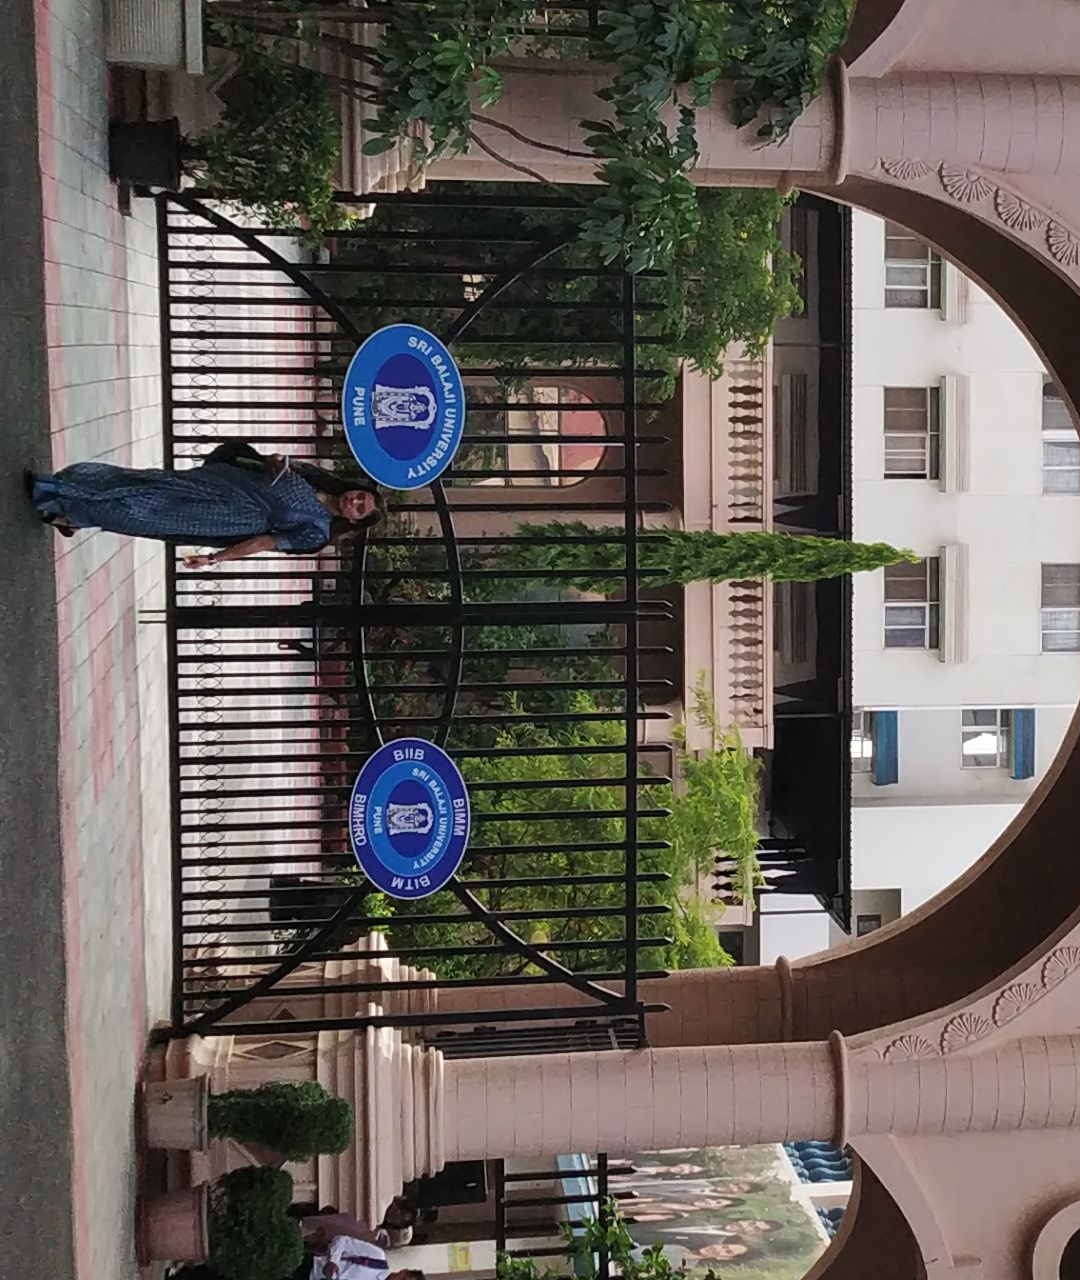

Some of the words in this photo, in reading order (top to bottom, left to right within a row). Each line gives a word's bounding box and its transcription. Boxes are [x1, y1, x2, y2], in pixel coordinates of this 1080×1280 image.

[407, 336, 433, 355] SRI
[430, 356, 457, 403] BALAJI
[352, 386, 366, 427] PUNE
[406, 408, 457, 479] UNIVERSITY
[392, 748, 425, 761] BIIB
[411, 768, 430, 781] SRI
[429, 780, 447, 814] BALAJI
[352, 793, 367, 846] BIMHRD
[373, 806, 383, 834] PUNE
[452, 798, 465, 836] BIMM
[412, 817, 448, 870] UNIVERSITY
[390, 875, 431, 892] BITM
